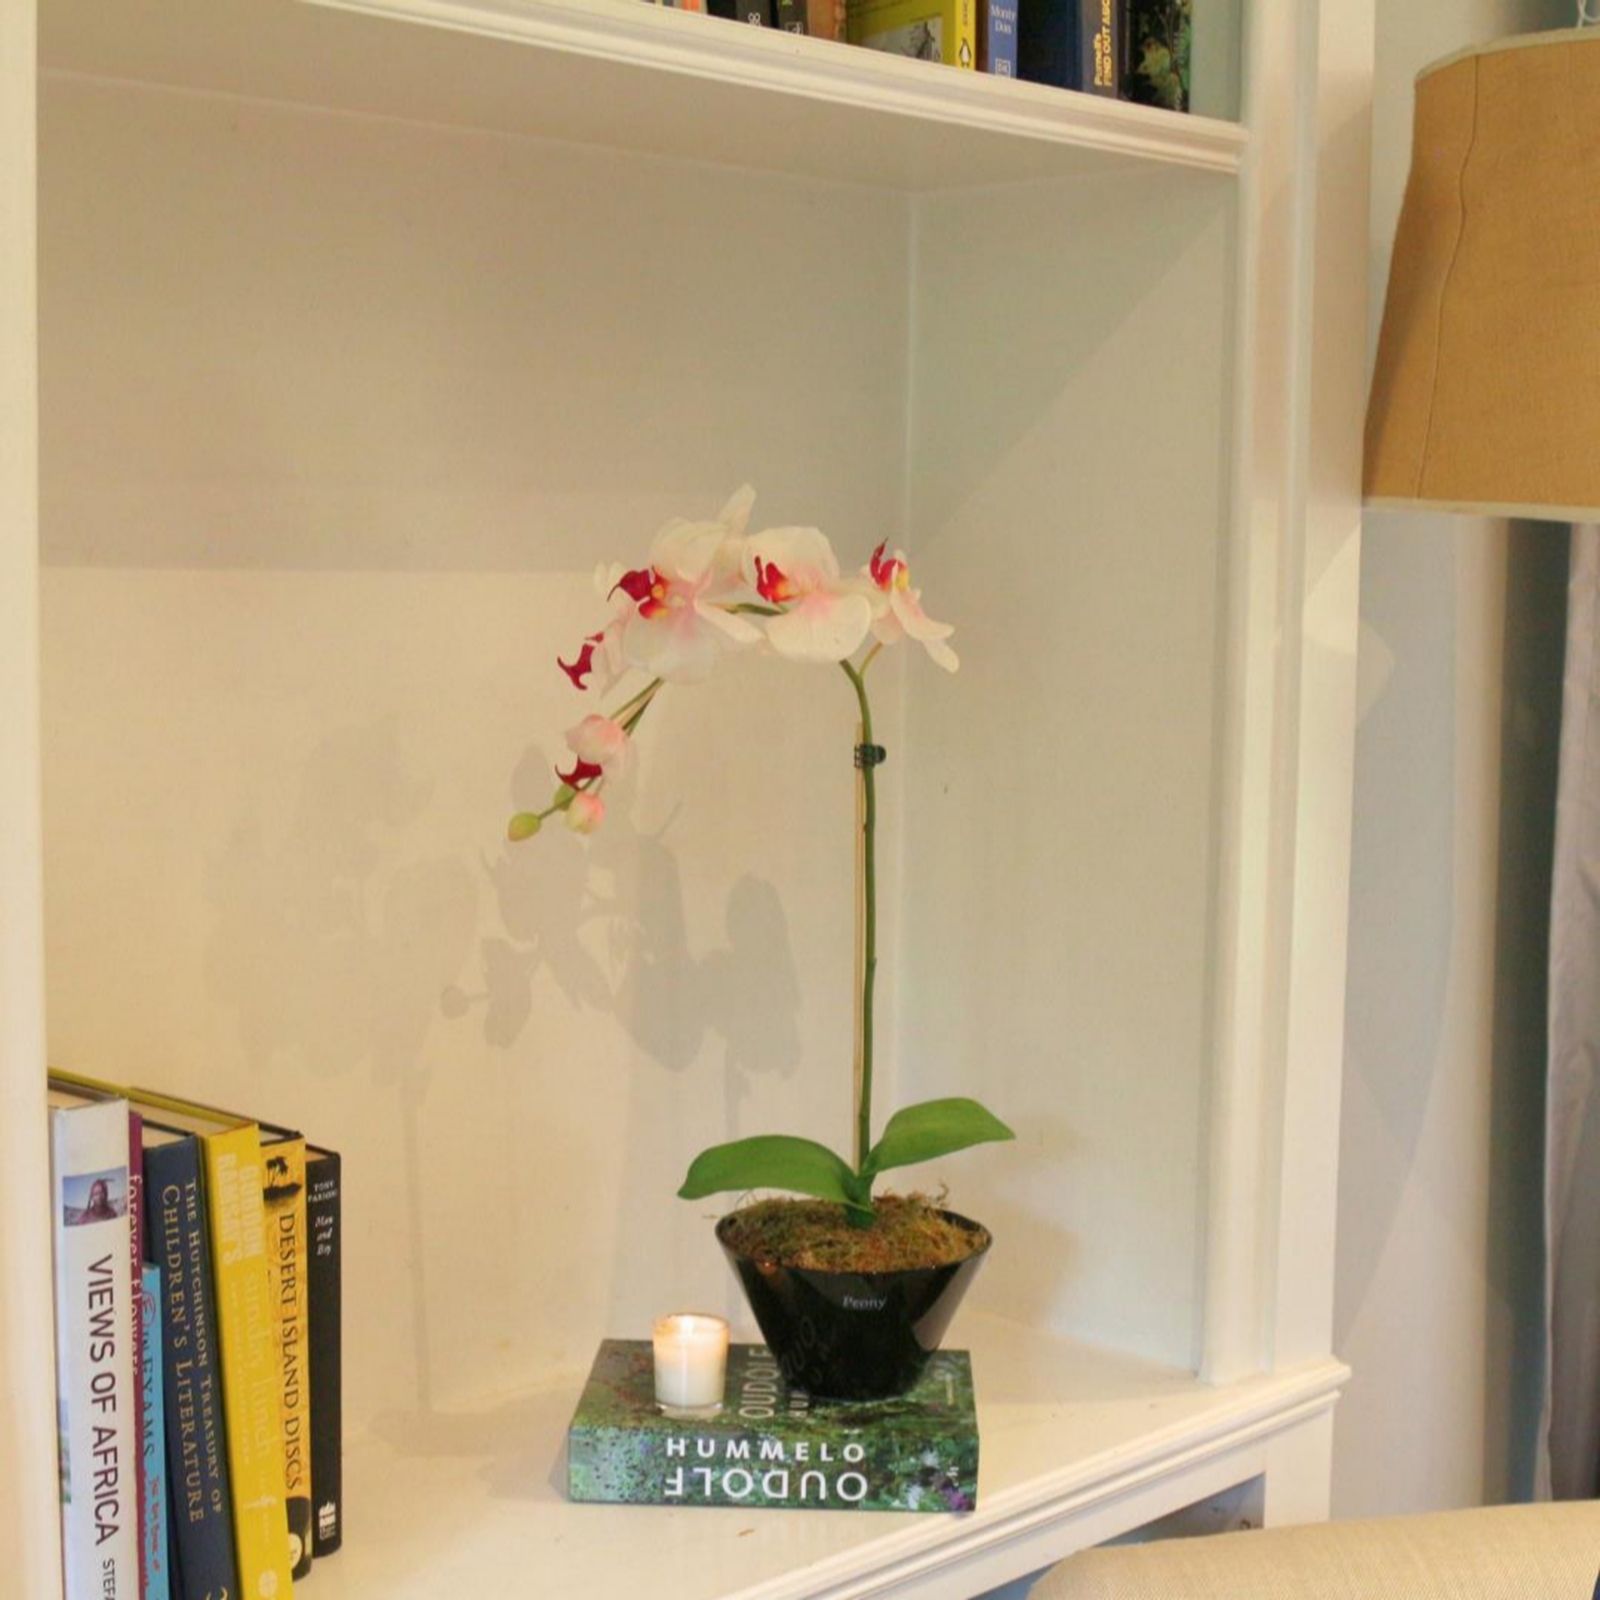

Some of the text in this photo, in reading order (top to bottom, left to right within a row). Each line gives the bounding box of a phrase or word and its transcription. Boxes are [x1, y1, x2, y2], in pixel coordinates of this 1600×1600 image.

[1102, 26, 1111, 54] OUT
[1102, 55, 1113, 87] FIND
[313, 1179, 335, 1193] TONY
[842, 1295, 887, 1311] Peony
[161, 1184, 204, 1523] CHILDREN'S LITERATURE
[185, 1176, 222, 1514] THE HUTCHINSON TREASURY OF
[279, 1213, 302, 1491] DESERT ISLAND DISCS
[87, 1253, 119, 1546] VIEWS OF AFRICA
[666, 1437, 865, 1462] HUMMELO
[664, 1466, 868, 1501] OUDOLF
